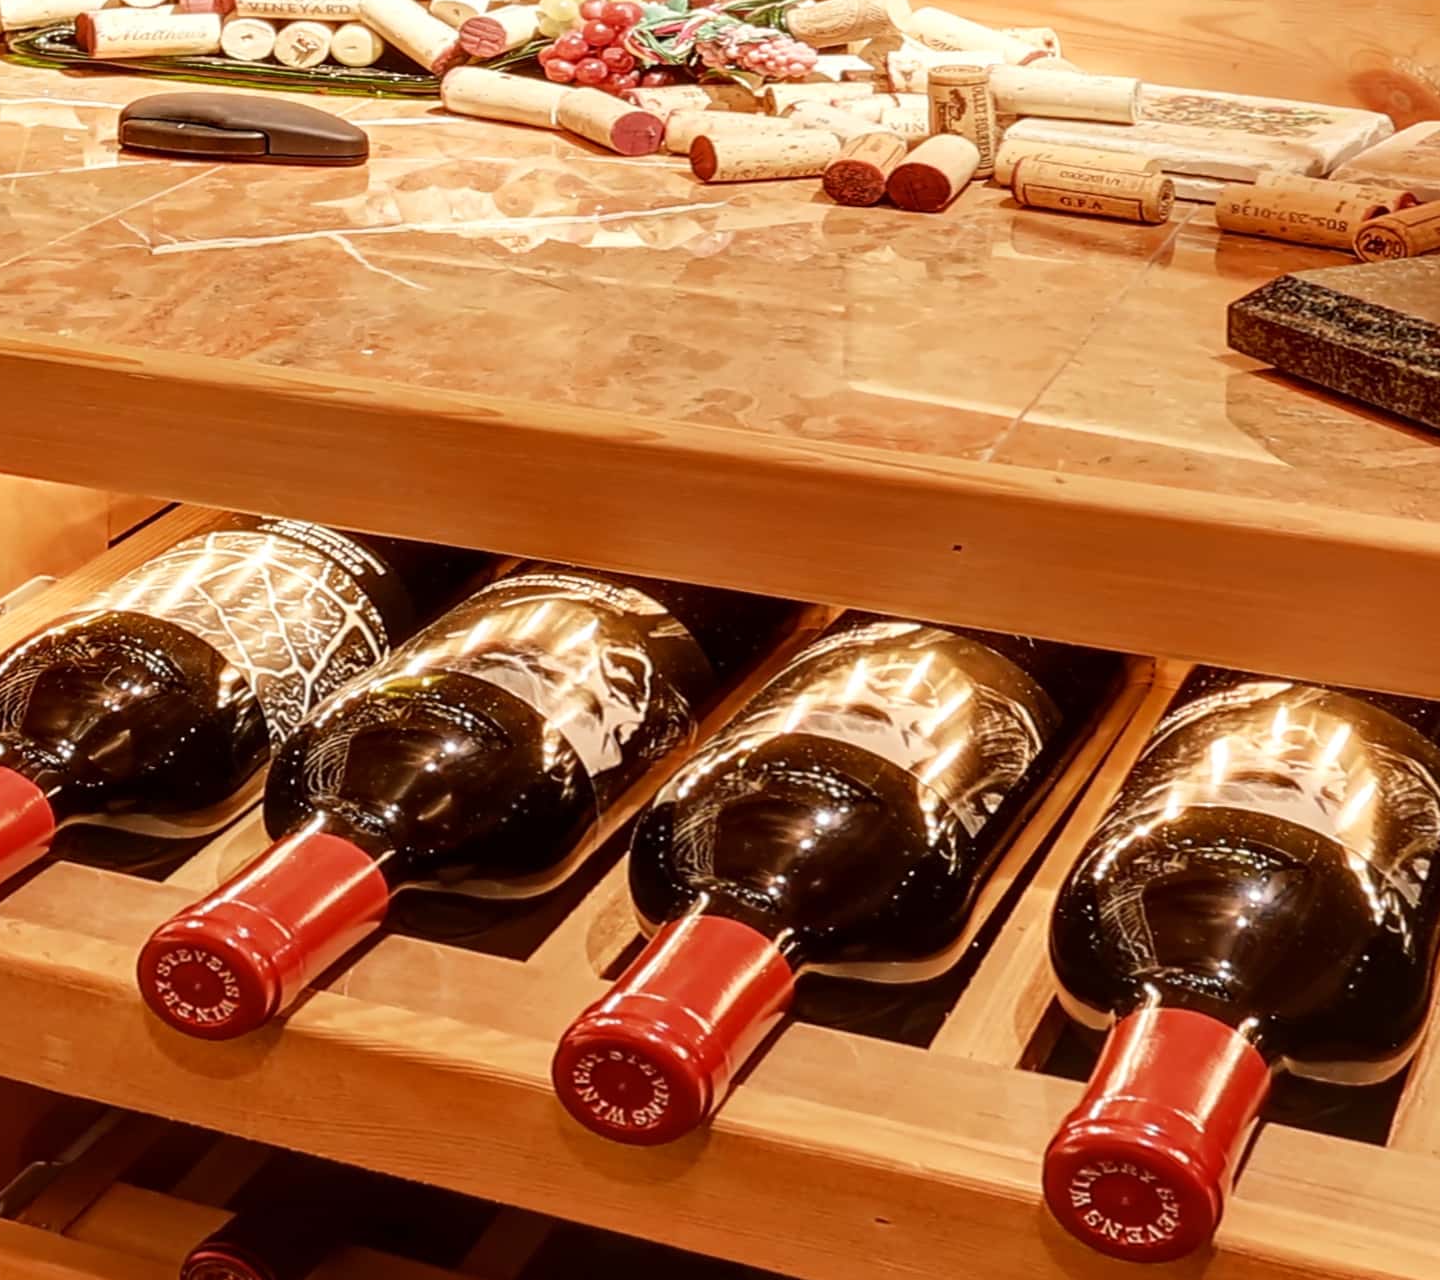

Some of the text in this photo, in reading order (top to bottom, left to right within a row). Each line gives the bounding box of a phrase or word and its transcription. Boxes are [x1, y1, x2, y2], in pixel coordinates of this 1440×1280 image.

[247, 2, 353, 17] VINEYARD
[154, 948, 240, 1023] STEVENS WINERY
[1067, 1160, 1182, 1245] STEVENS WINERY
